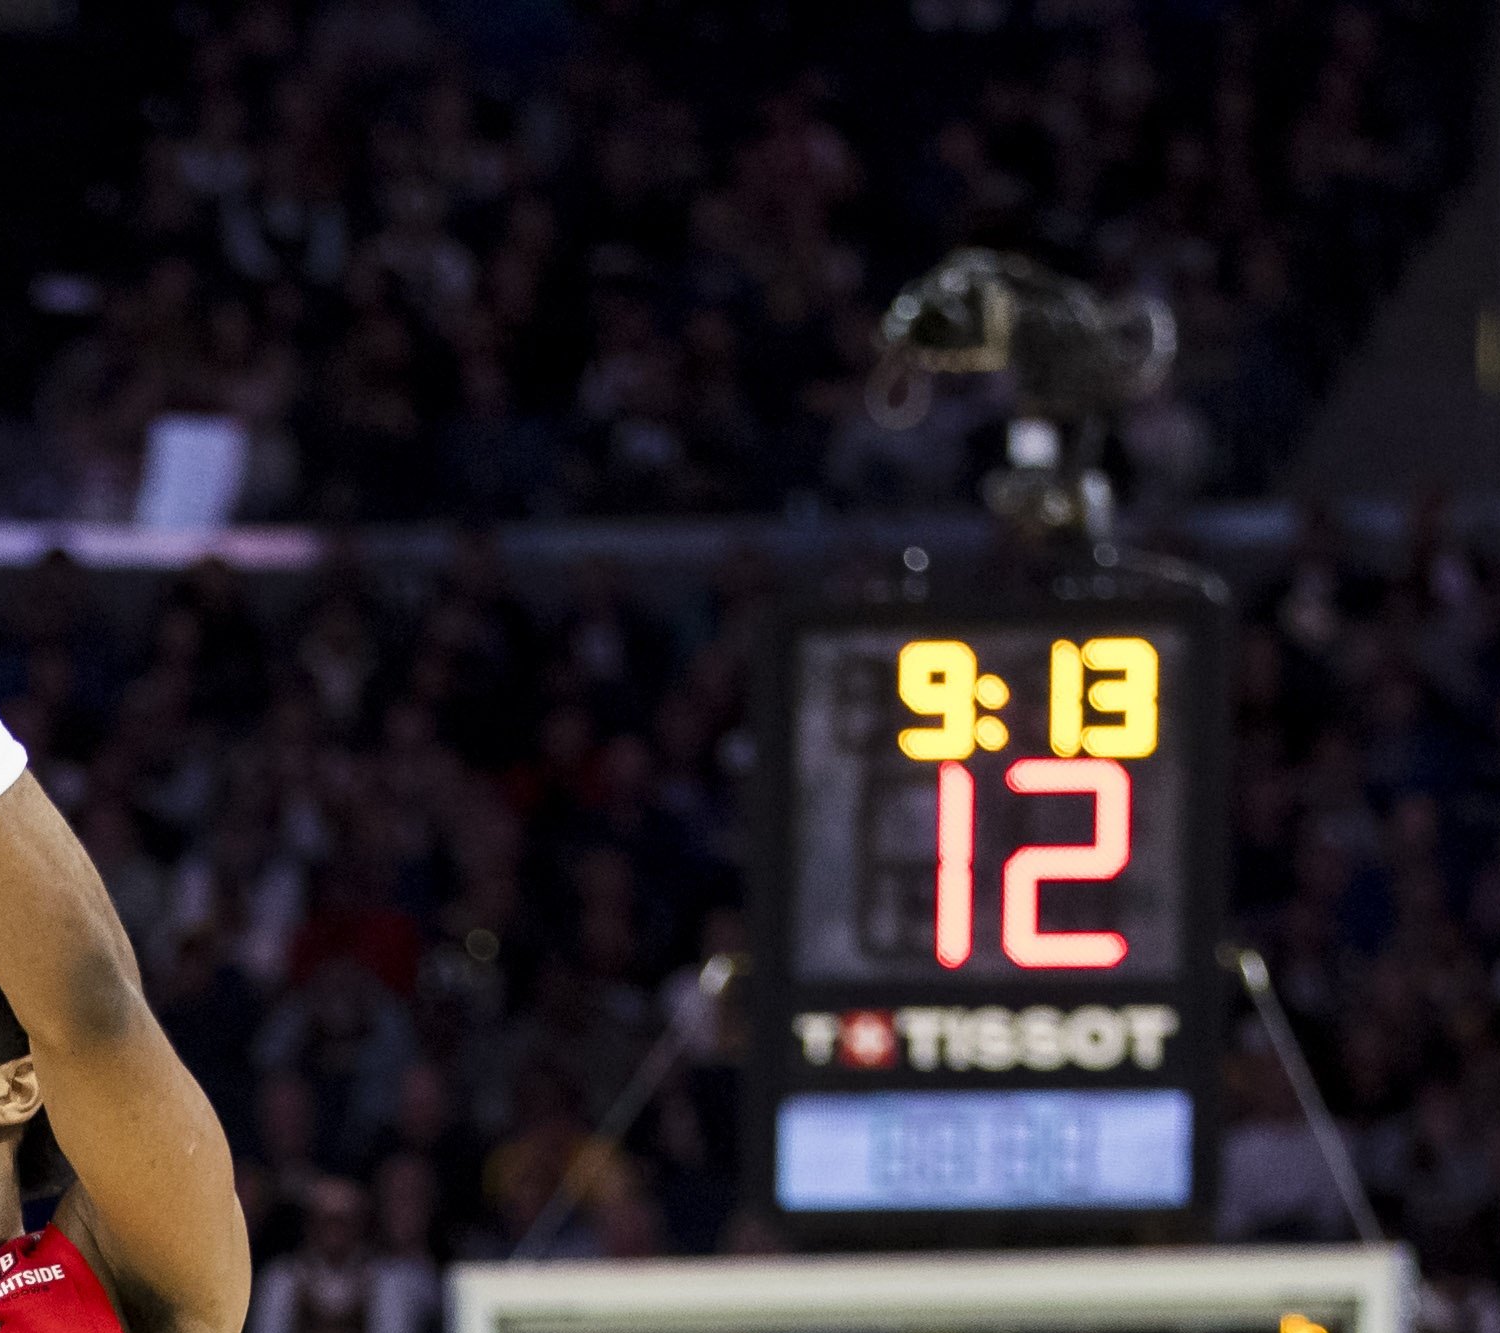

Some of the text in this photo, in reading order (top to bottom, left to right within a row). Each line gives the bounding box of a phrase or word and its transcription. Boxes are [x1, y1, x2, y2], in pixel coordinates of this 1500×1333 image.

[898, 637, 1160, 760] 9:13
[935, 756, 1132, 969] 12
[896, 1004, 1181, 1071] TISSOT
